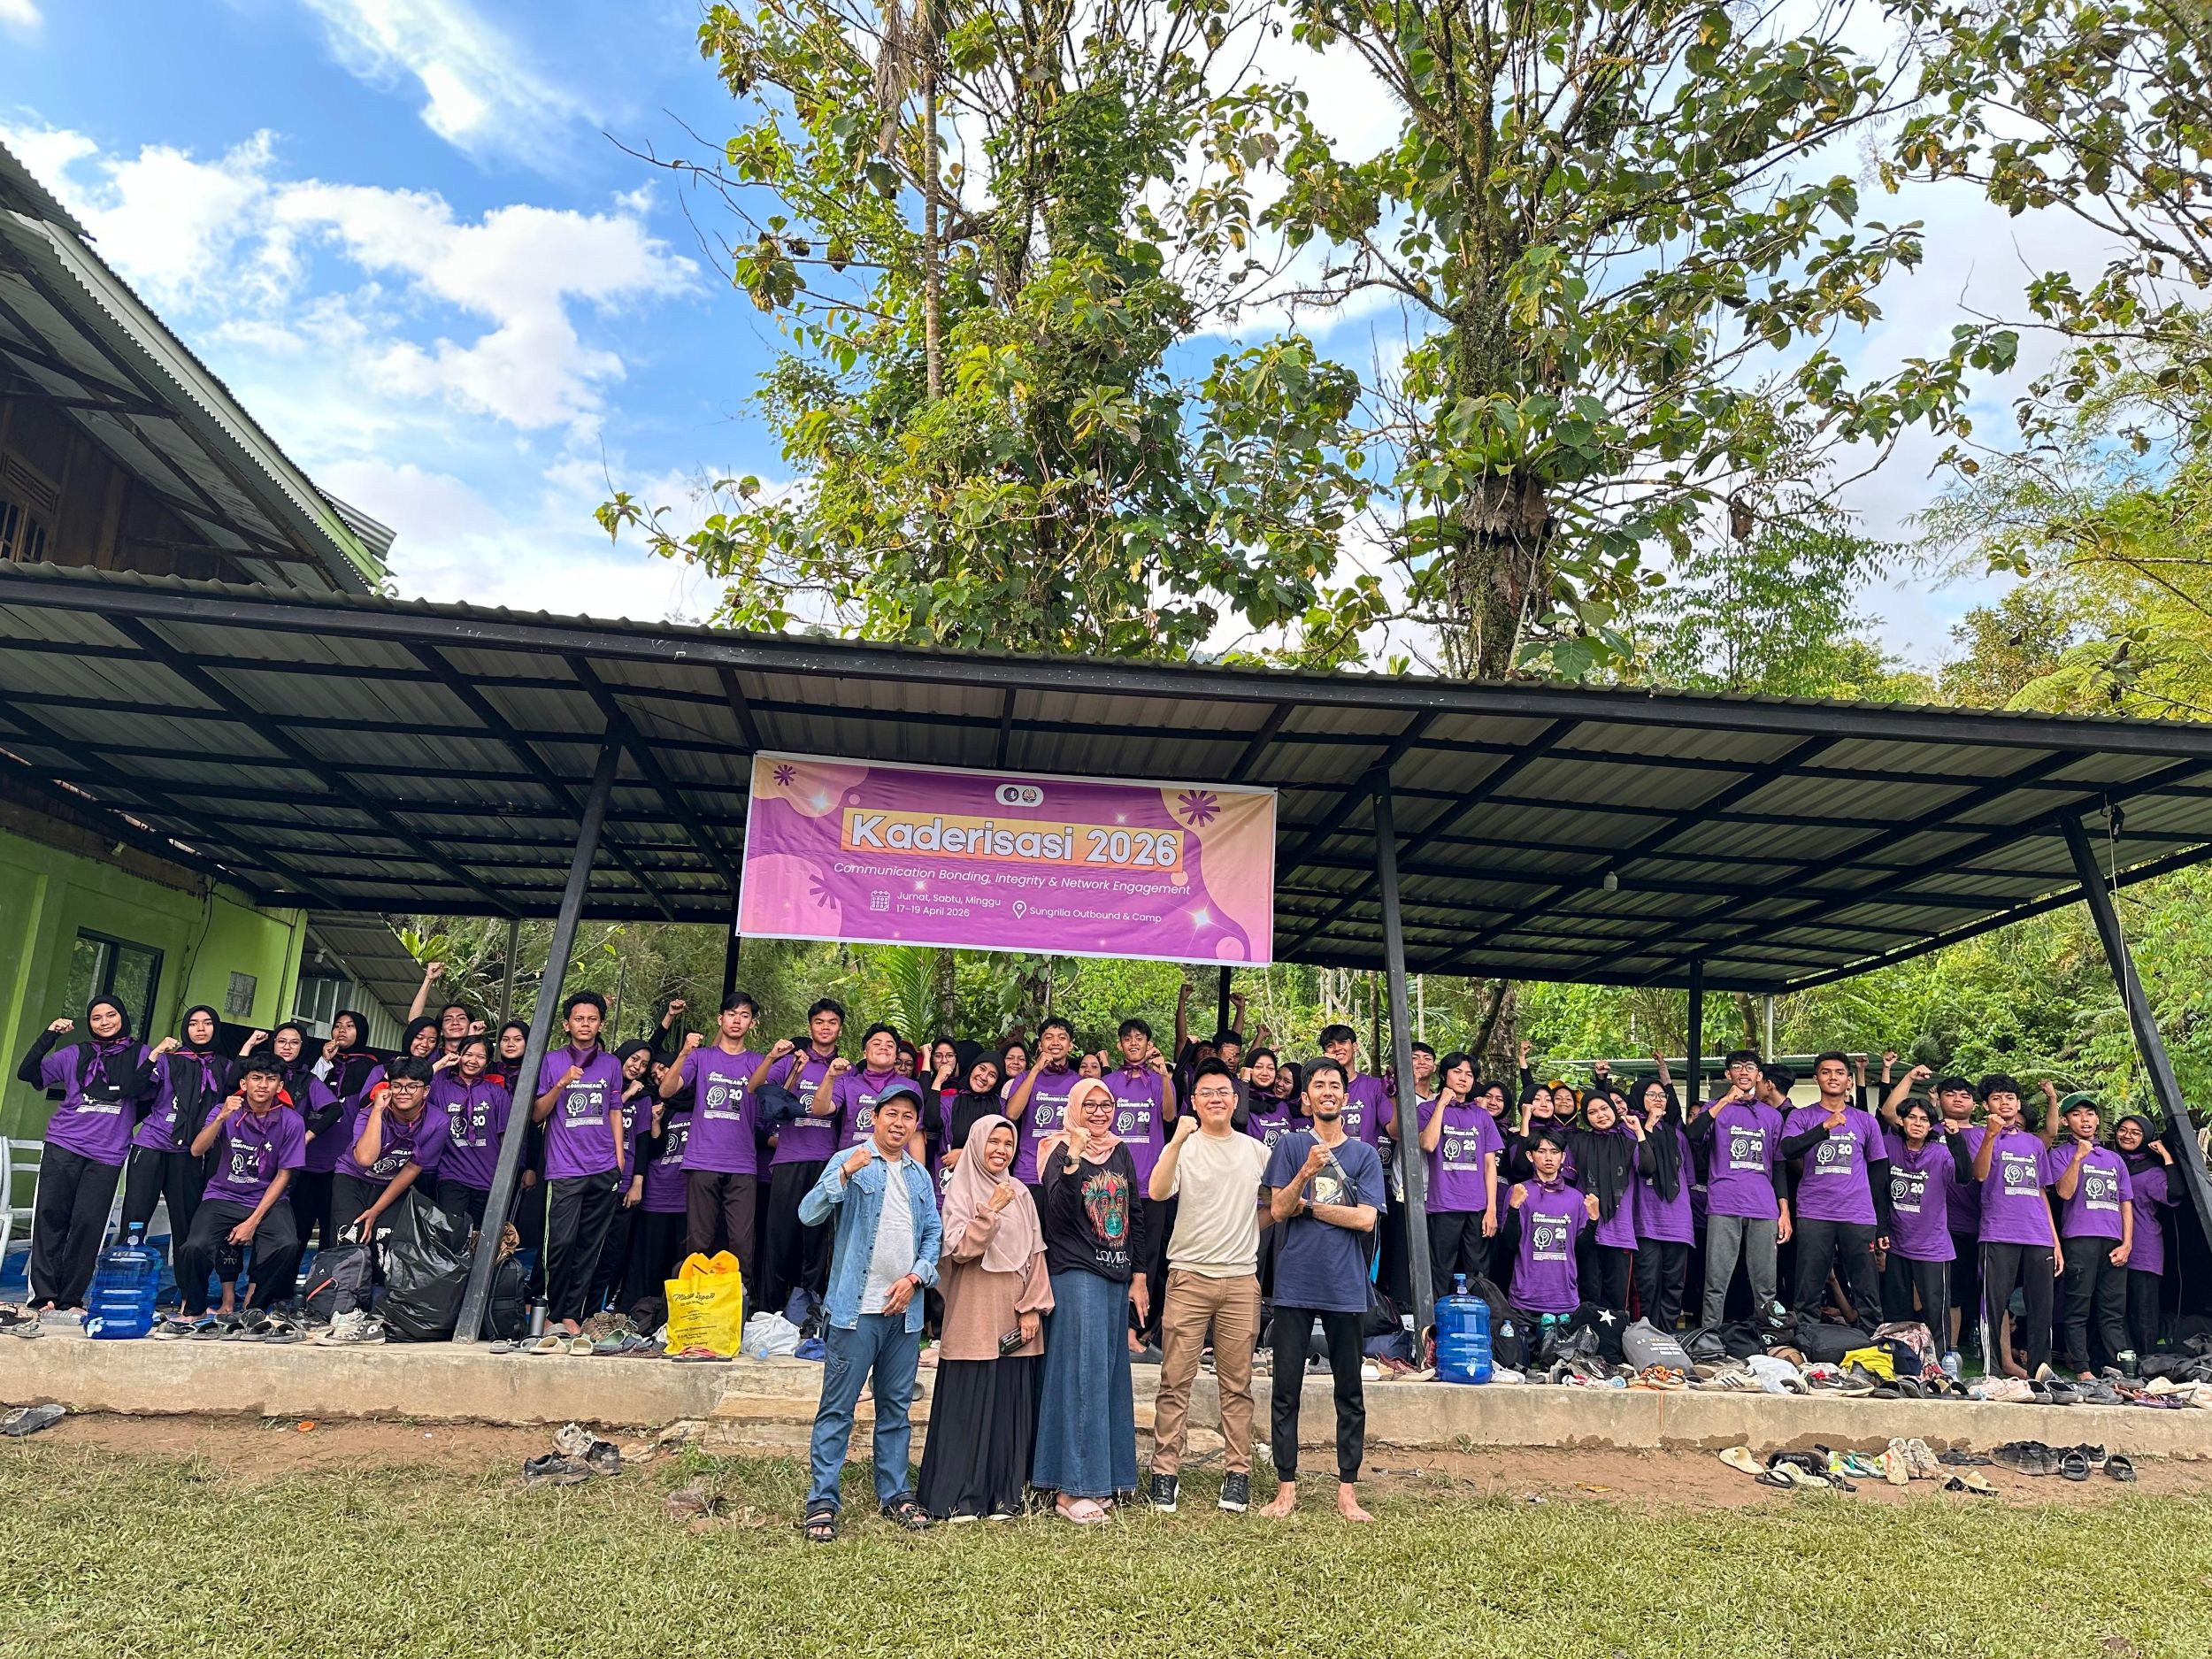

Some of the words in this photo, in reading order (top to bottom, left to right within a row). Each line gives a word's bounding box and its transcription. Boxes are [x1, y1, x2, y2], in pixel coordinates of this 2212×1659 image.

[851, 814, 1074, 860] Kaderisasi
[1085, 829, 1178, 867] 2026
[833, 862, 935, 879] Communication
[939, 870, 991, 886] Bonding,
[995, 873, 1045, 888] Integrity
[1048, 877, 1058, 887] &
[1061, 878, 1110, 890] Network
[1113, 881, 1191, 895] Engagement
[896, 892, 930, 902] Jumat,
[933, 894, 963, 904] Sabtu,
[965, 896, 1002, 907] Minggu
[923, 906, 944, 917] April
[946, 907, 970, 918] 2026
[1030, 906, 1071, 918] Sungrilla
[1072, 909, 1120, 920] Outbound
[1132, 912, 1162, 924] Camp
[589, 1092, 603, 1104] 20
[728, 1088, 742, 1101] 20
[1056, 1105, 1064, 1117] 2
[1137, 1110, 1150, 1123] 20
[472, 1115, 486, 1126] 20
[1347, 1113, 1361, 1125] 20
[1463, 1140, 1477, 1151] 20
[1750, 1140, 1763, 1152] 20
[1838, 1143, 1853, 1156] 20
[2024, 1165, 2036, 1178] 20
[1910, 1182, 1924, 1194] 20
[2106, 1179, 2117, 1192] 20
[1555, 1227, 1567, 1240] 20
